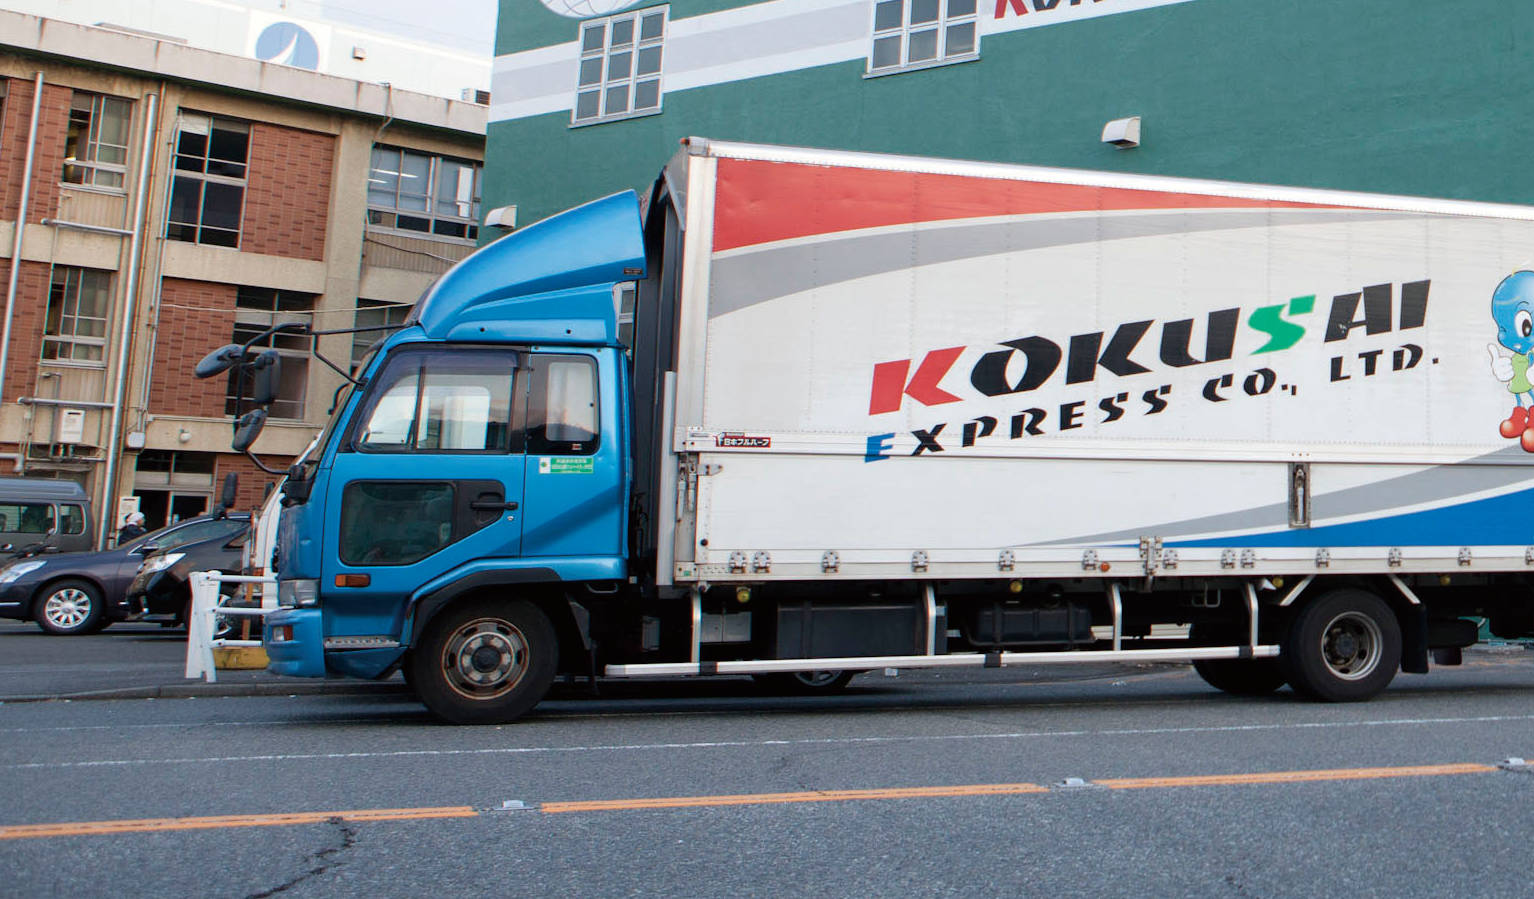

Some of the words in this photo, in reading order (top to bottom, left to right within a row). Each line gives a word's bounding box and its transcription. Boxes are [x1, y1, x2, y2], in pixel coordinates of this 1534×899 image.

[864, 384, 1172, 463] EXPRESS
[1330, 343, 1439, 382] LTD.
[869, 279, 1431, 416] KOKUSAI
